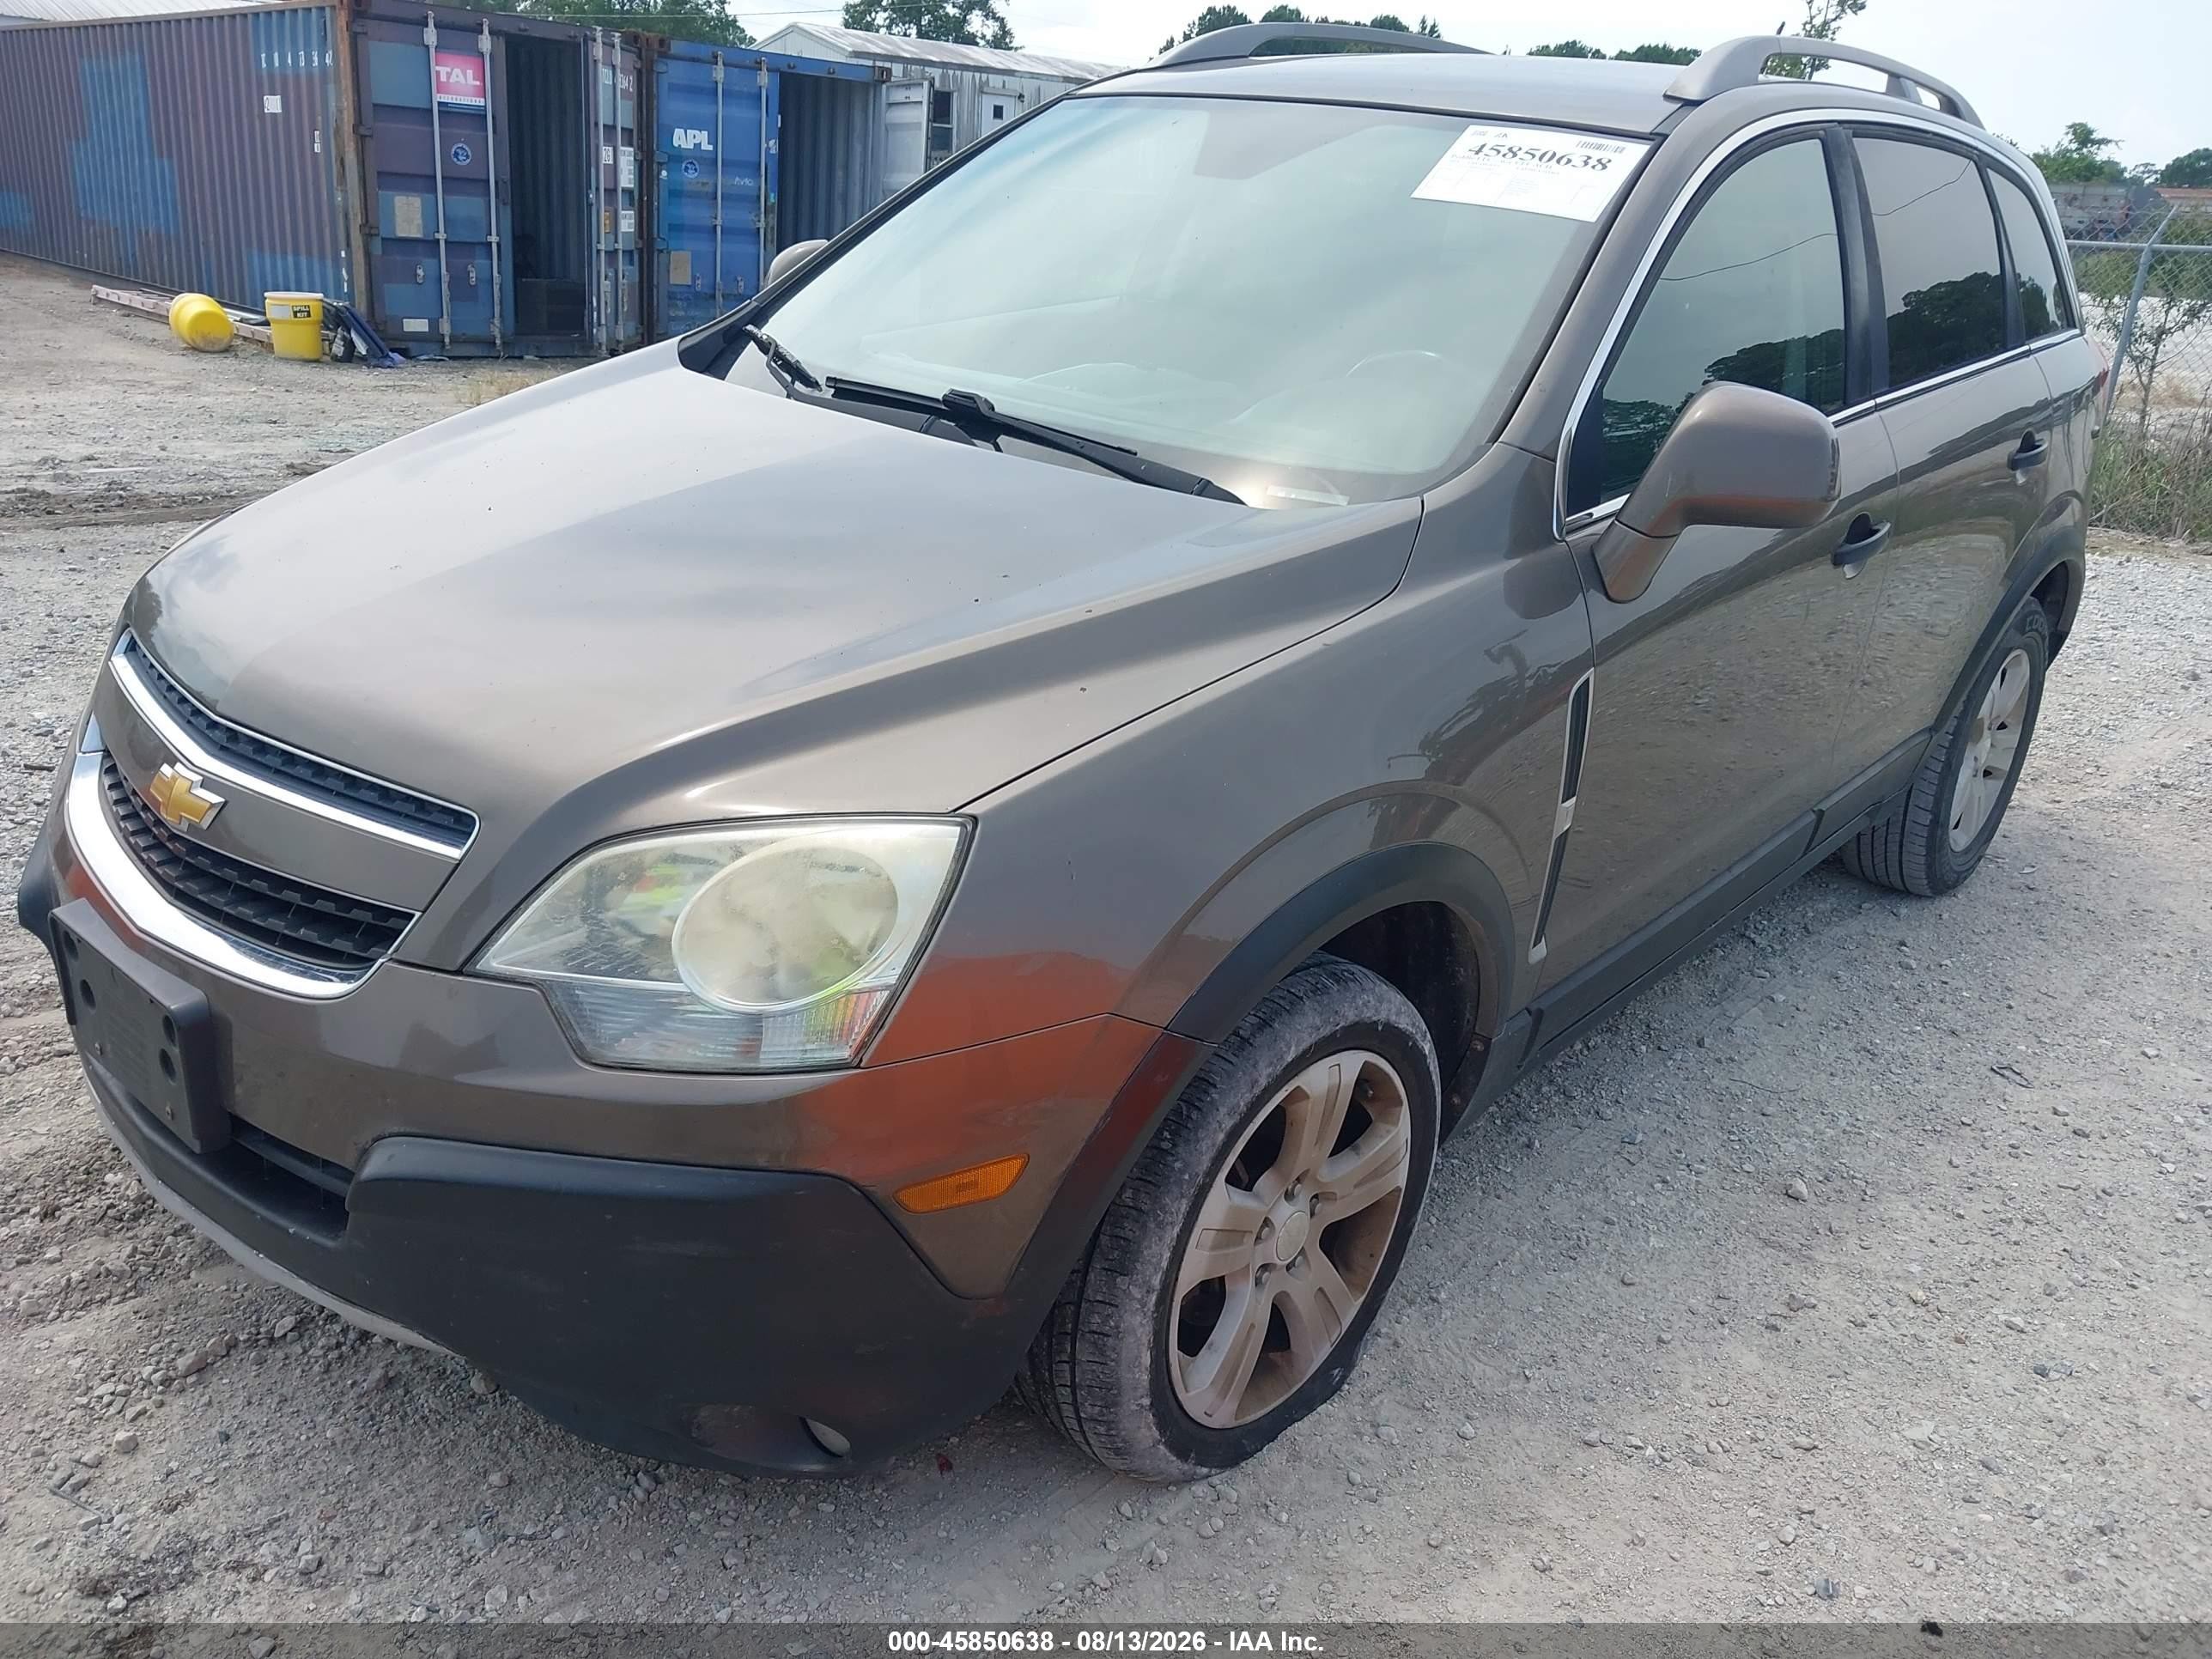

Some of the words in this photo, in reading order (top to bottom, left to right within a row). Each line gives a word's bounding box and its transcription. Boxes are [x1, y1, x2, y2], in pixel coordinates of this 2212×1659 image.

[435, 66, 480, 85] TAL
[672, 128, 714, 150] APL
[1468, 143, 1613, 172] 45850638
